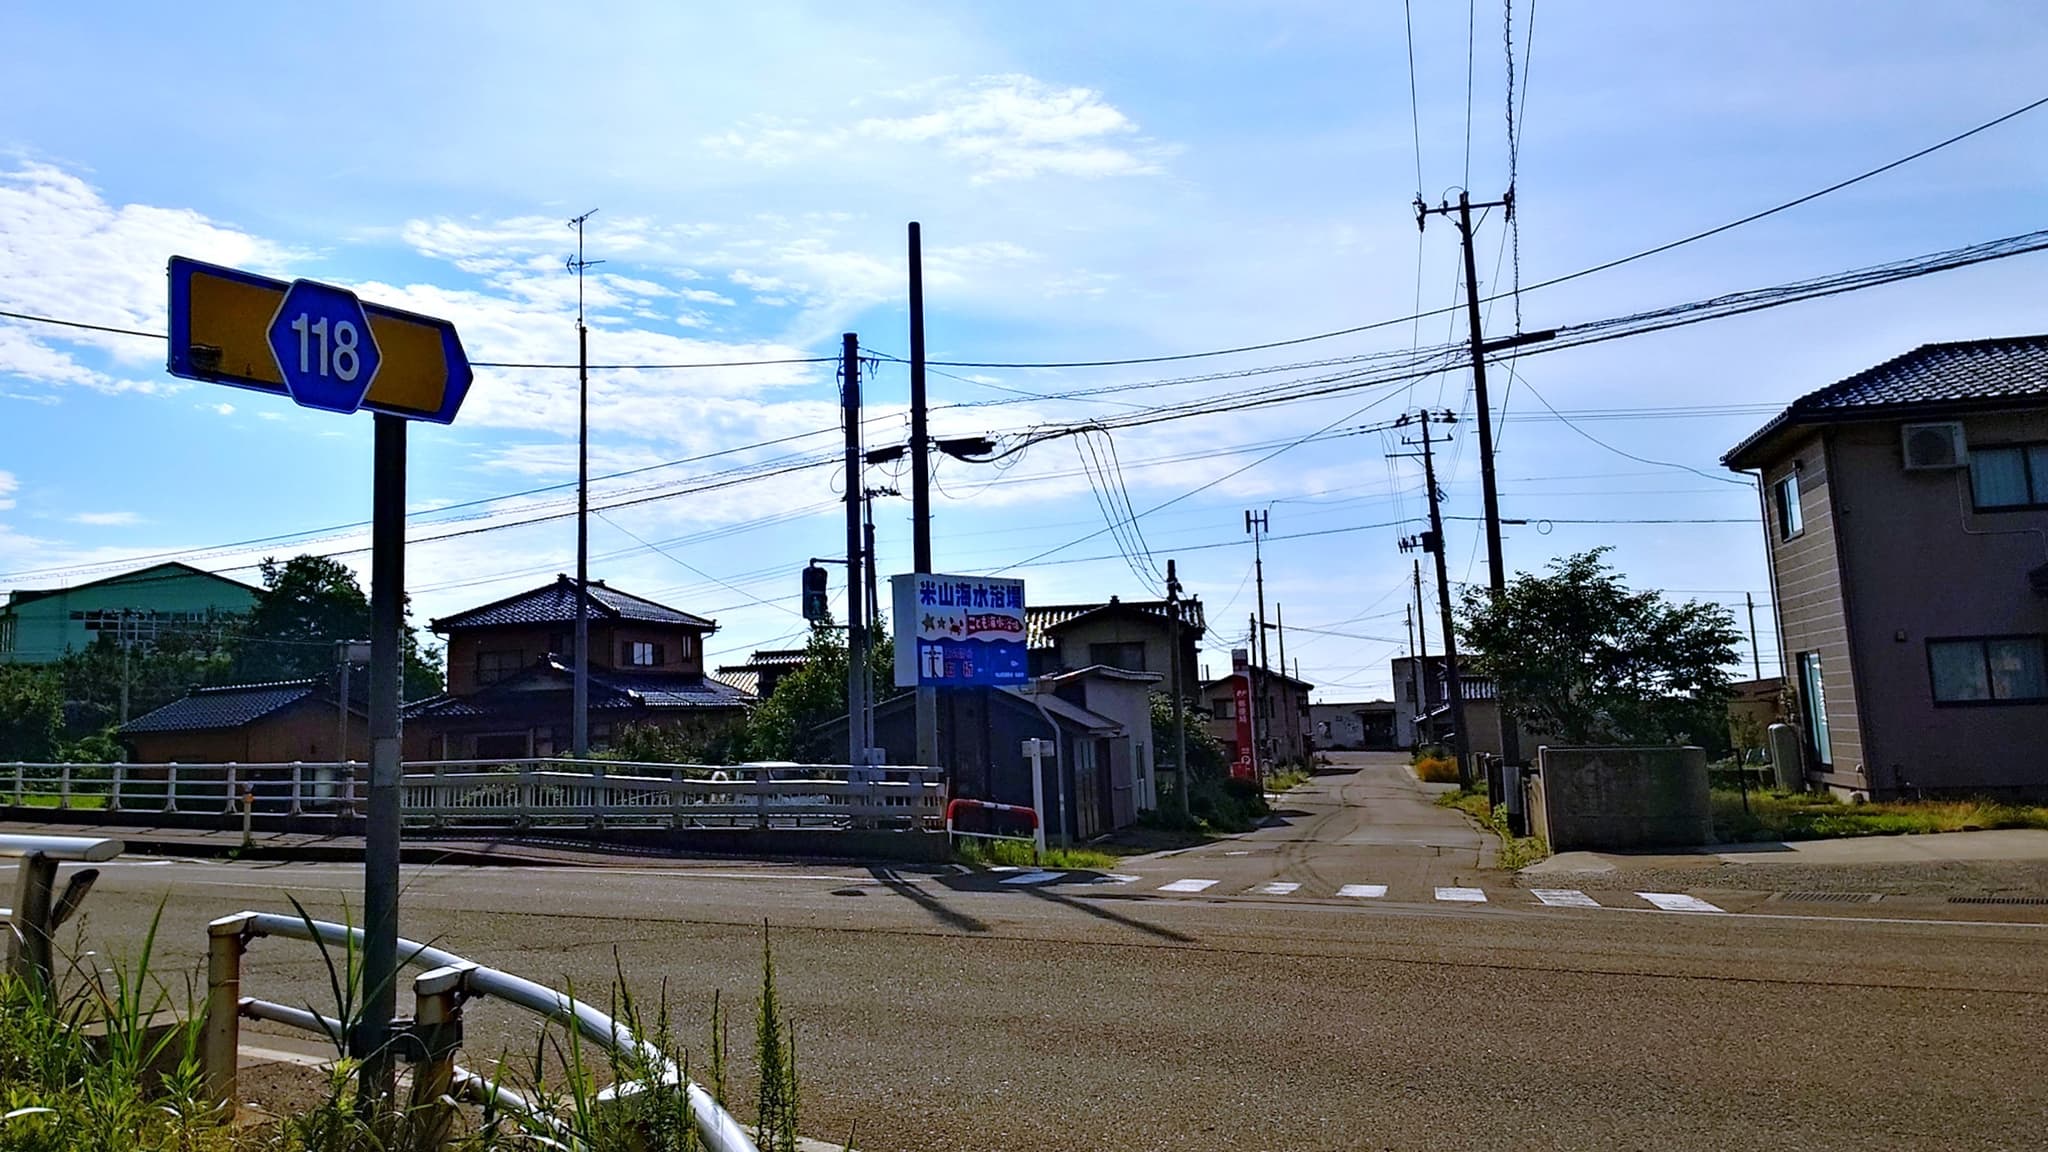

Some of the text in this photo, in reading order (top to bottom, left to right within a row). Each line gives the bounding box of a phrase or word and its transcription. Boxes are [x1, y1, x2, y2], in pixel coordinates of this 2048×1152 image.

[292, 313, 360, 381] 118
[920, 581, 1022, 609] 米山海水浴場
